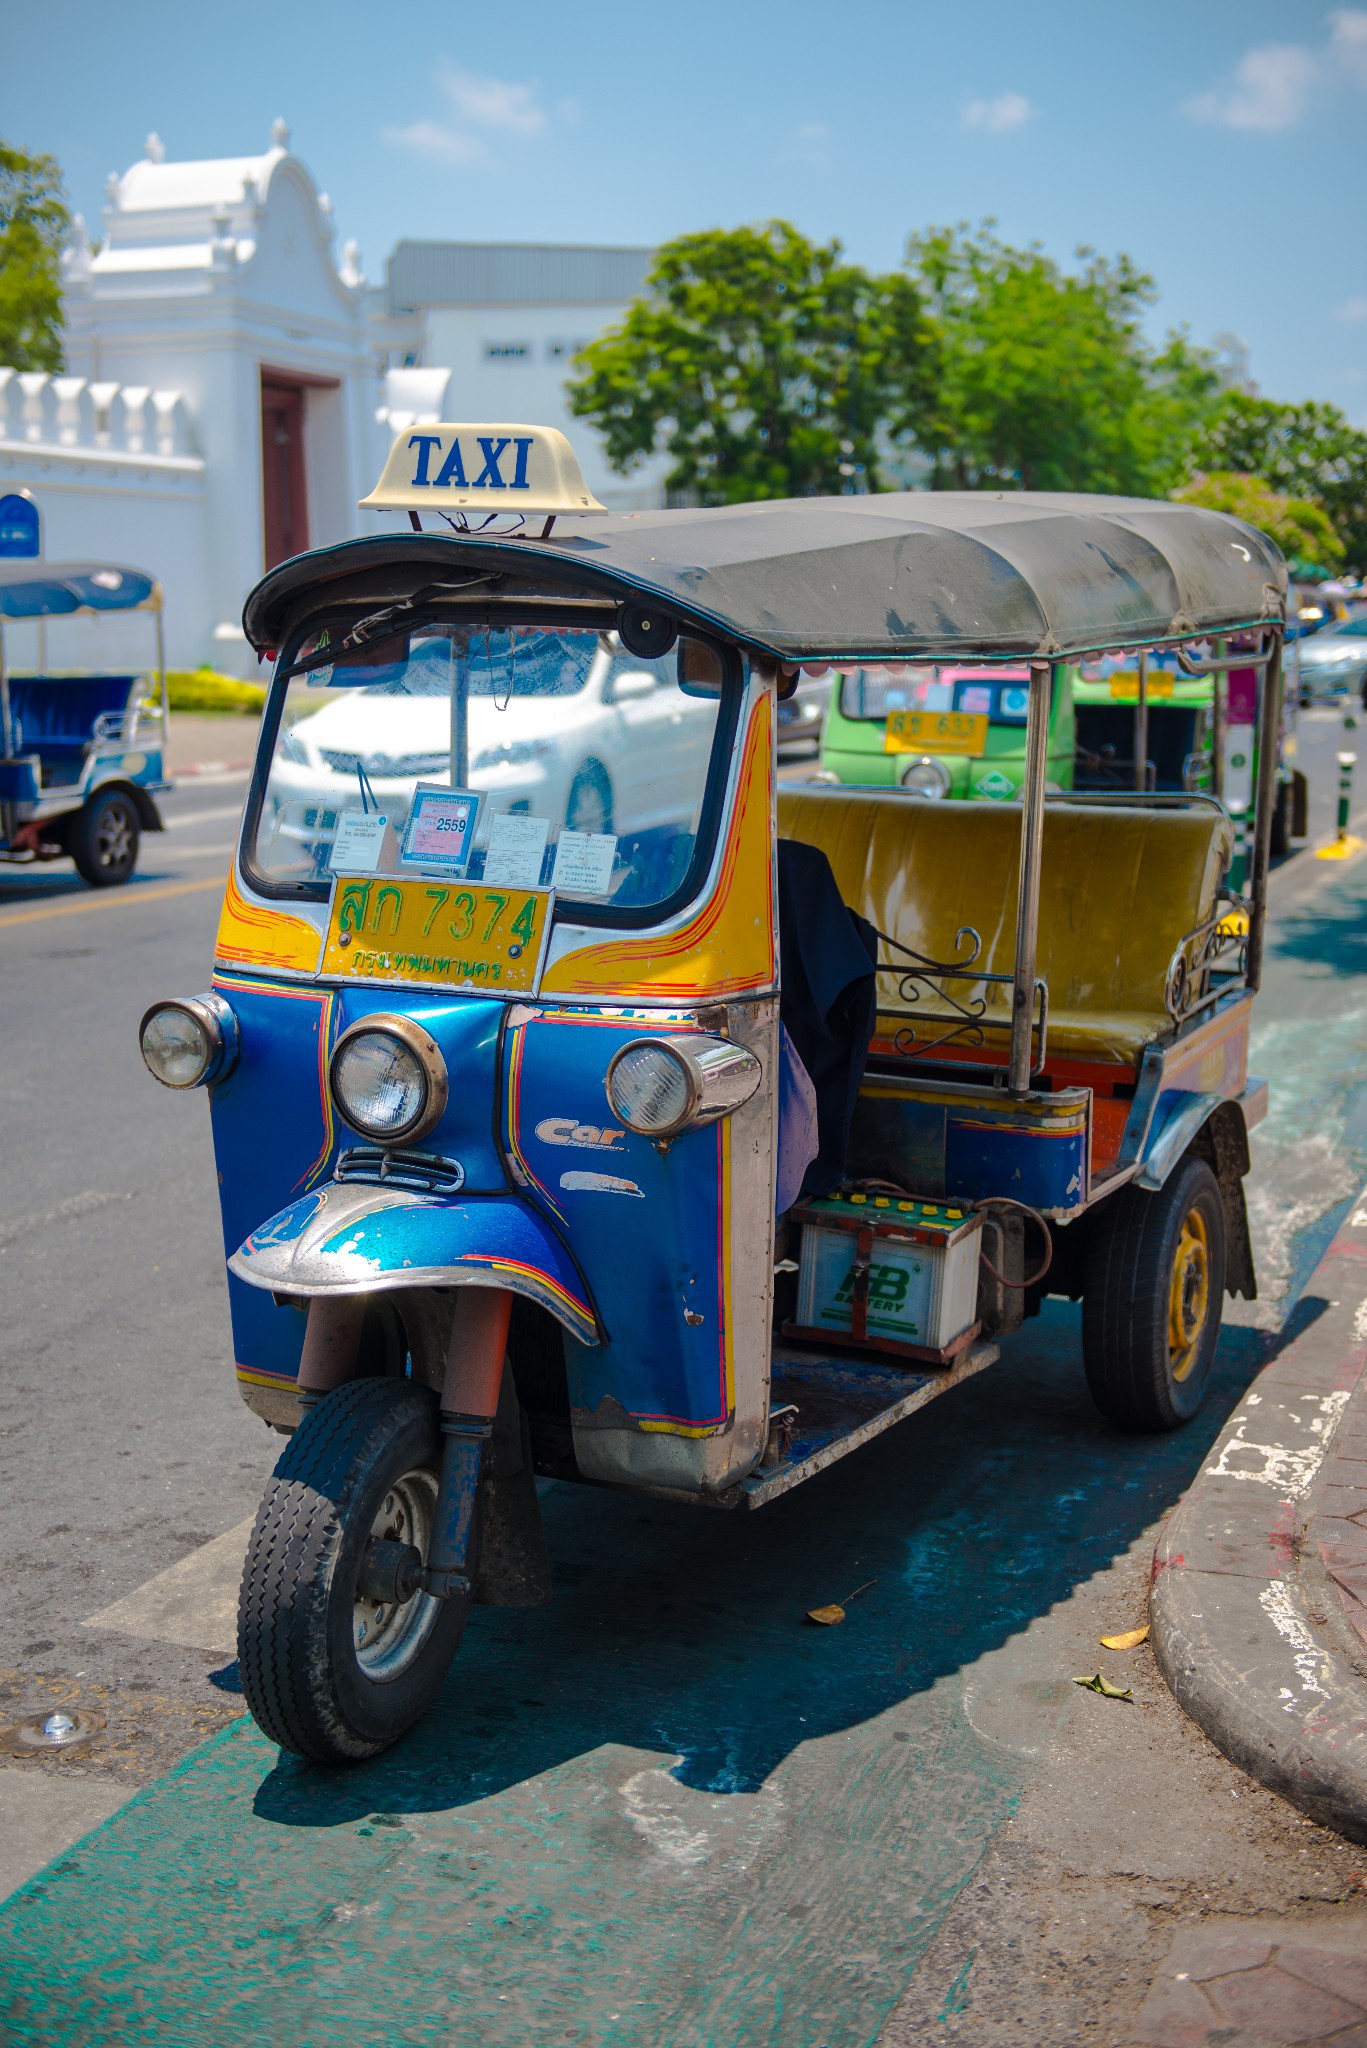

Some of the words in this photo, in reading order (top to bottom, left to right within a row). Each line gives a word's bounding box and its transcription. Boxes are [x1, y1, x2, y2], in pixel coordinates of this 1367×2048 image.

[408, 435, 534, 489] TAXI
[436, 817, 467, 833] 2559
[339, 880, 403, 935] สก
[421, 888, 538, 947] 7374
[352, 949, 502, 979] กรุงเทพมหานคร
[535, 1118, 625, 1146] Car
